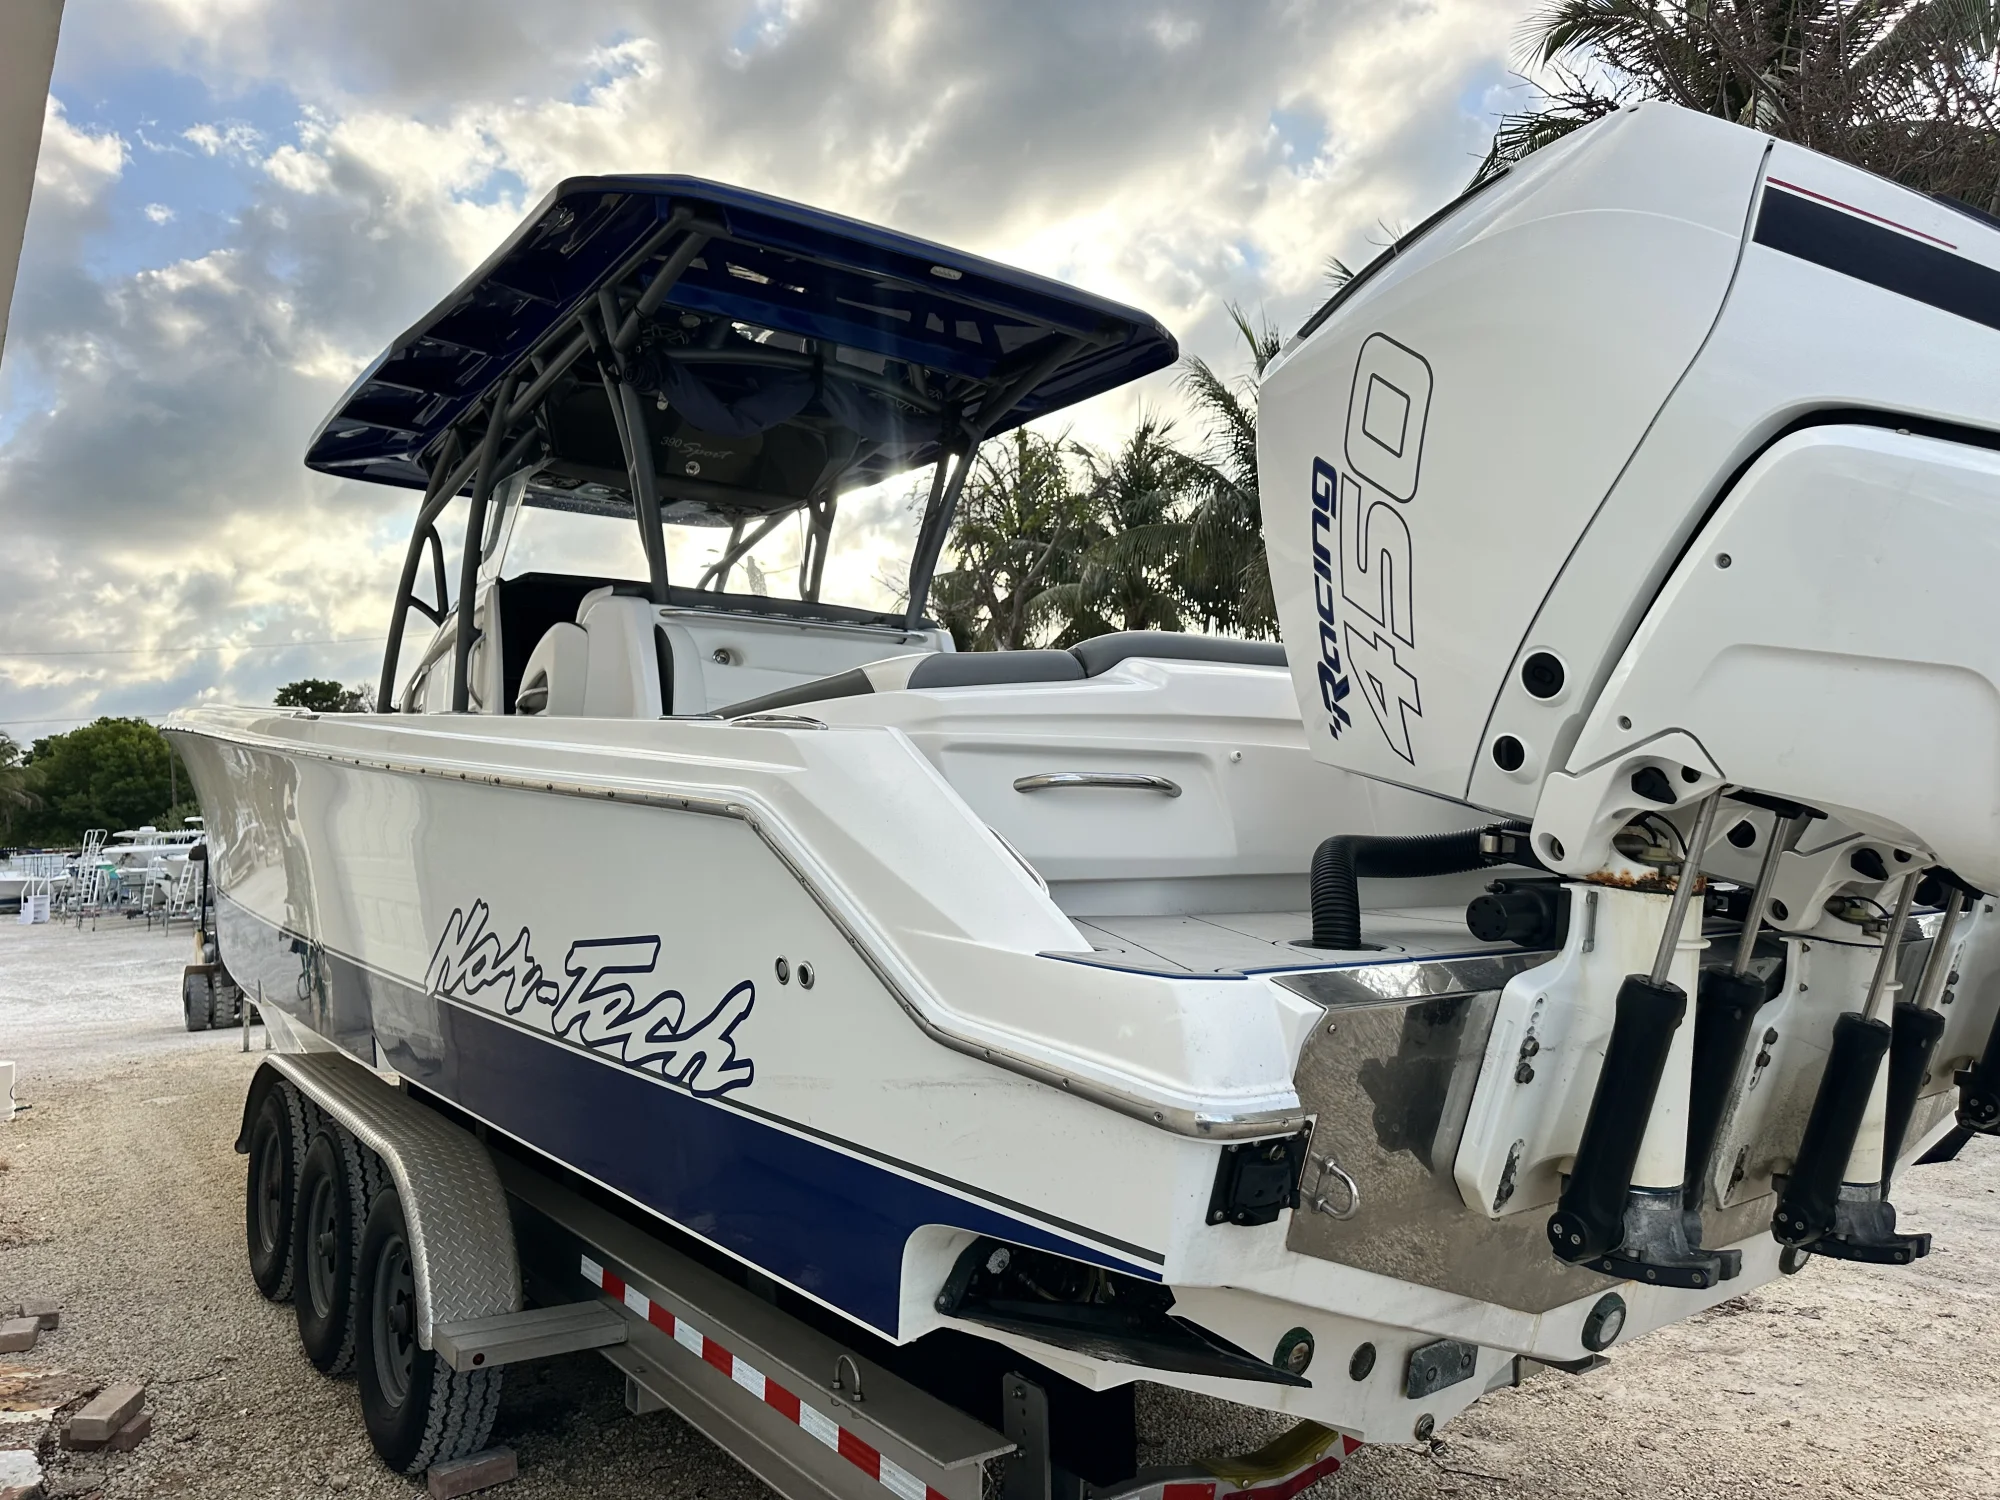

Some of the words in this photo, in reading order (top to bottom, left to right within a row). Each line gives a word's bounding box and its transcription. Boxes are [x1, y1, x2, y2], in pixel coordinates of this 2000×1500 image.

[660, 436, 683, 448] 390
[679, 442, 736, 460] Sport
[1340, 332, 1433, 766] 450
[1312, 456, 1352, 733] Racing
[425, 898, 756, 1099] Nor-Tech
